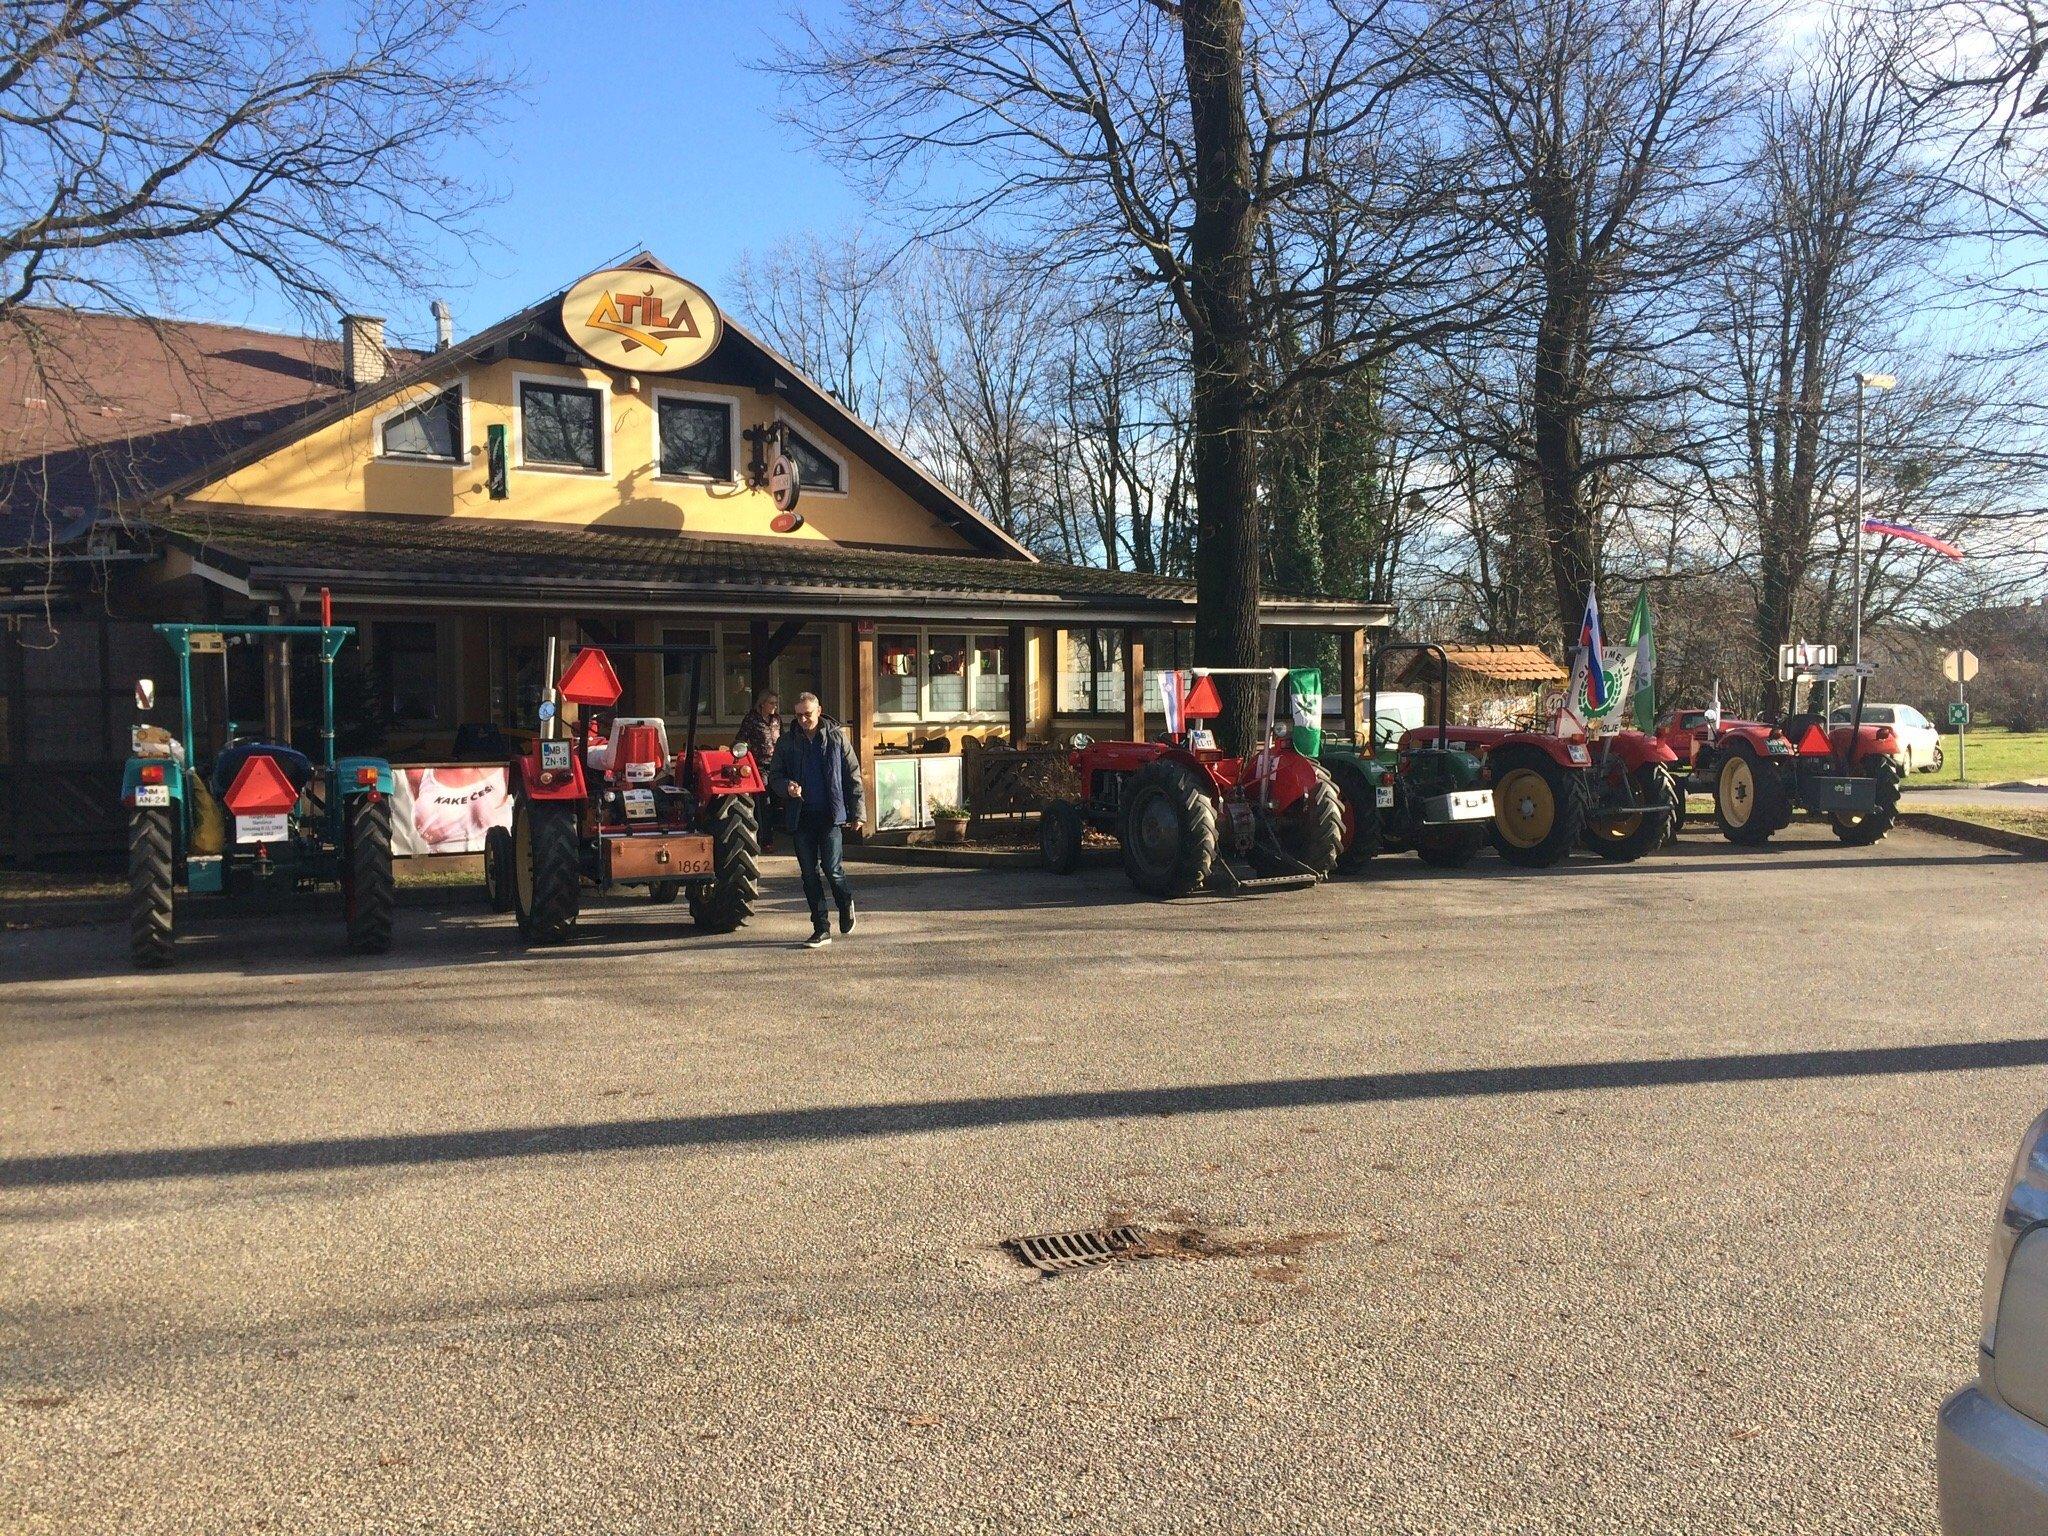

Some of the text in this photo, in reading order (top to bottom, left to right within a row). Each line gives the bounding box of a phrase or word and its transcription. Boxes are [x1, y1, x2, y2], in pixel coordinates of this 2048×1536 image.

[545, 756, 568, 767] ZN-18
[434, 796, 468, 805] KAKE
[678, 860, 711, 874] 1862
